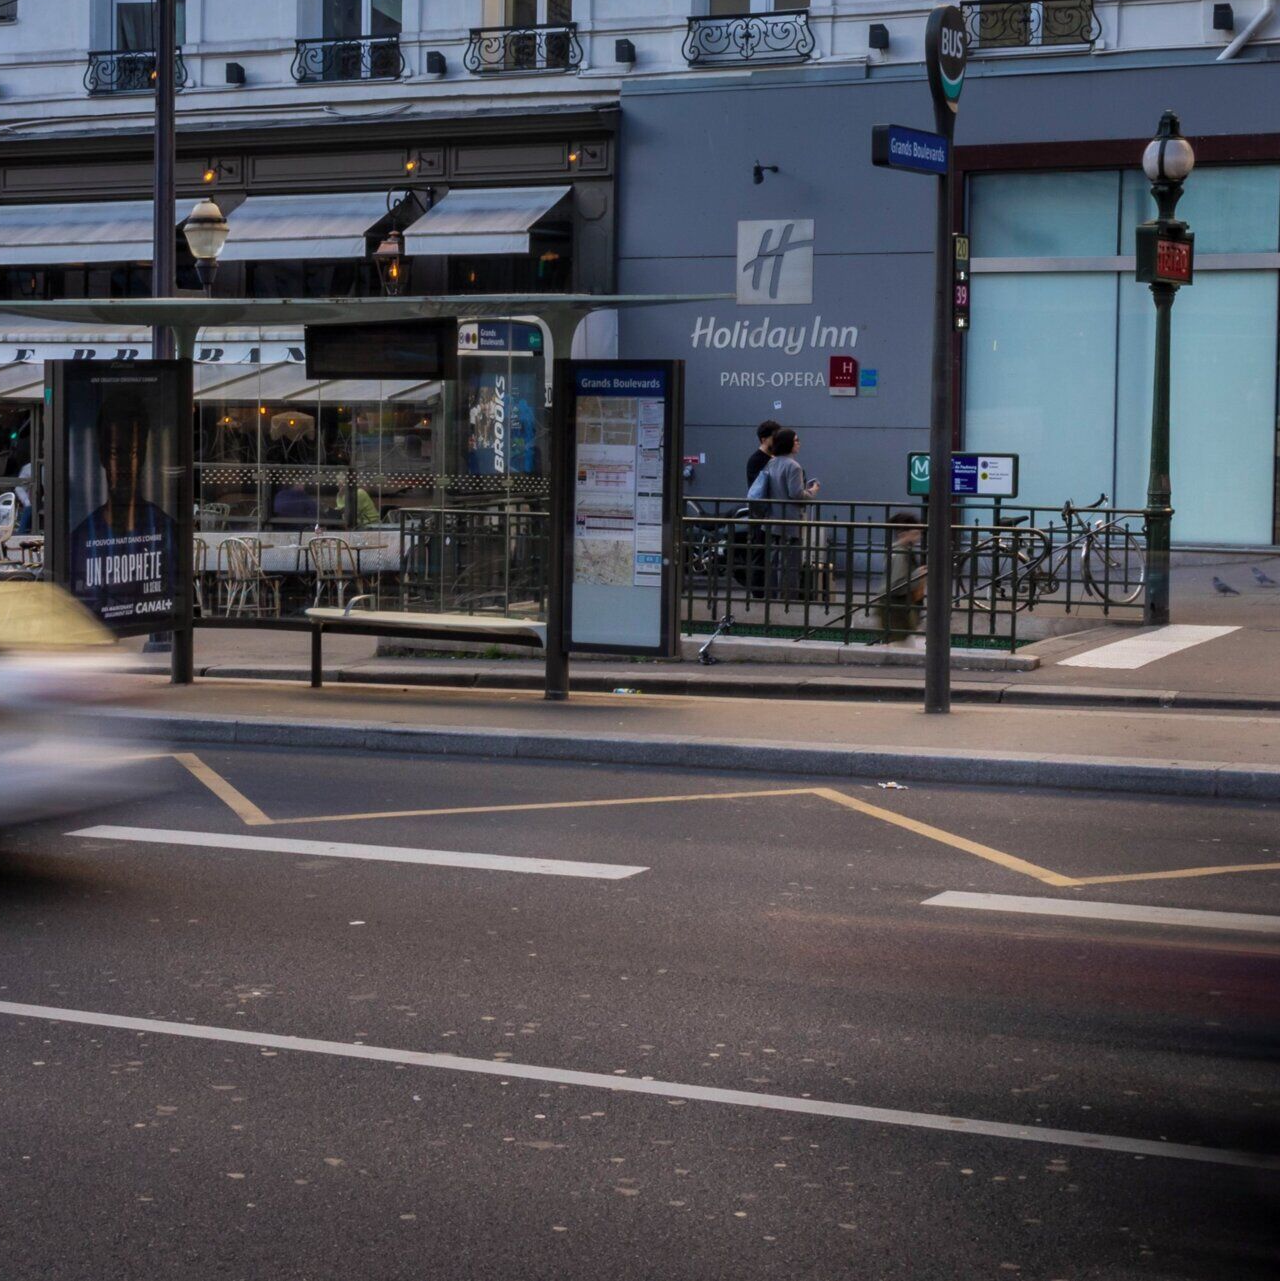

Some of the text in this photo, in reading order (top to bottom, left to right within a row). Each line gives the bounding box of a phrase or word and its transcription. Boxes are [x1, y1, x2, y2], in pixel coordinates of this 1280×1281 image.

[941, 27, 963, 59] BUS
[890, 137, 945, 163] Grands Boulevards
[956, 240, 967, 258] 20
[955, 286, 968, 305] 39
[690, 315, 859, 356] Holiday Inn
[842, 361, 853, 374] H
[581, 378, 661, 389] Grands Boulevards
[720, 371, 826, 388] PARIS-OPERA
[494, 373, 505, 474] BROOKS
[86, 548, 162, 587] UN PROPHÈTE
[143, 582, 149, 594] LA
[135, 598, 173, 614] CANAL+
